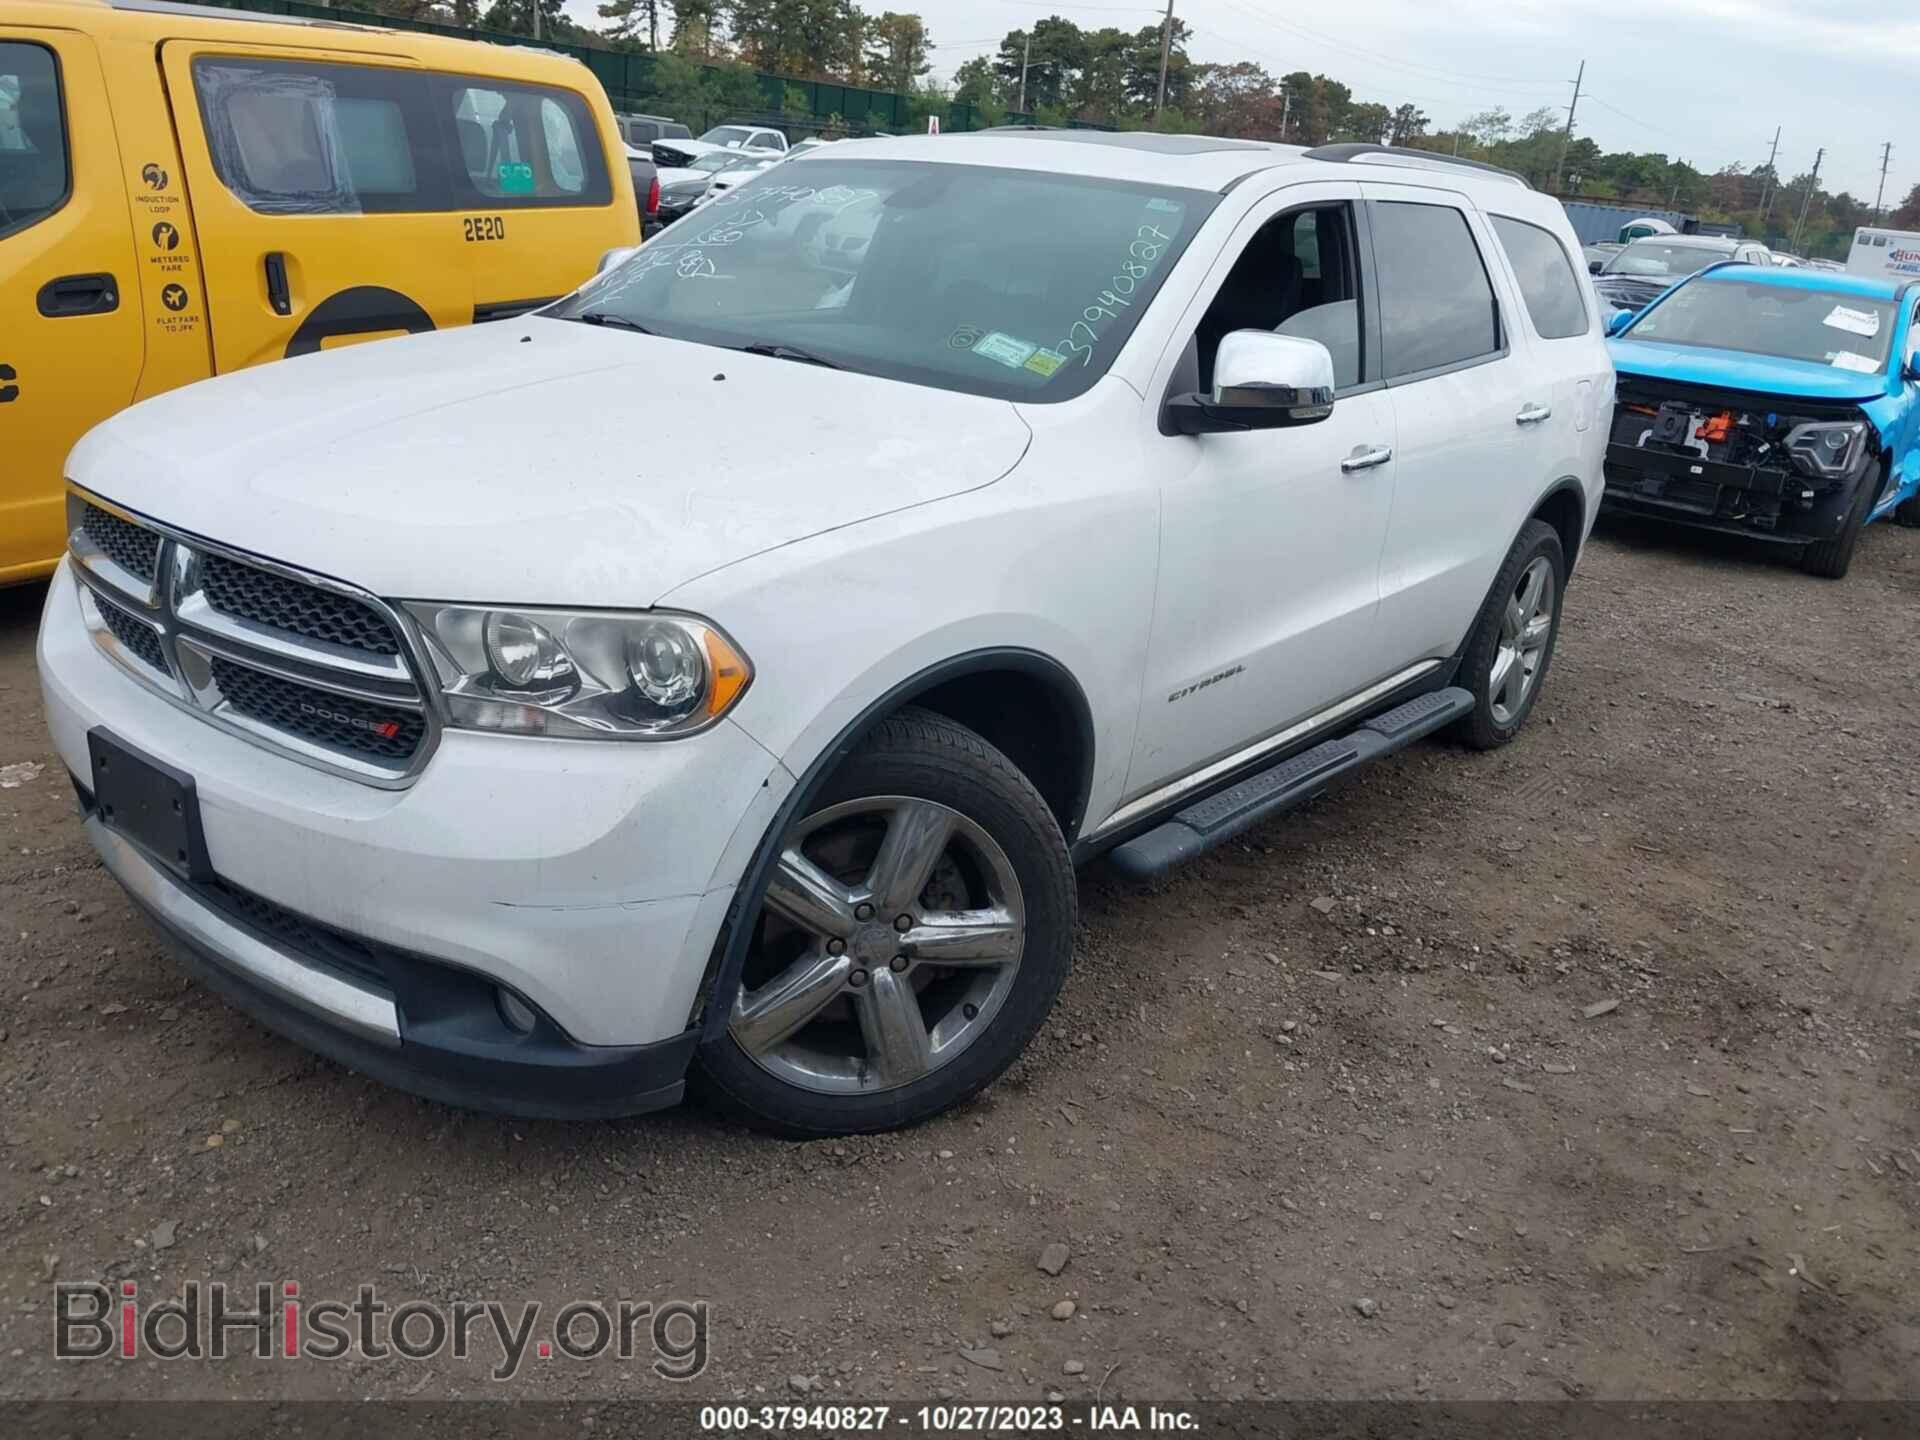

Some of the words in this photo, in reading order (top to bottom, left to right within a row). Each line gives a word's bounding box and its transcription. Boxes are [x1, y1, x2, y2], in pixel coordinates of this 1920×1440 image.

[136, 195, 179, 203] INDUCTION
[151, 206, 170, 214] LOOP
[464, 216, 504, 242] 2E20
[150, 255, 190, 264] METERED
[161, 264, 182, 272] FARE
[1056, 223, 1170, 367] 37940827
[157, 316, 177, 325] FLAT
[179, 315, 199, 323] FARE
[165, 324, 177, 333] TO
[179, 323, 193, 332] JFK
[1168, 664, 1247, 702] CITADEL
[301, 703, 386, 733] DODGE
